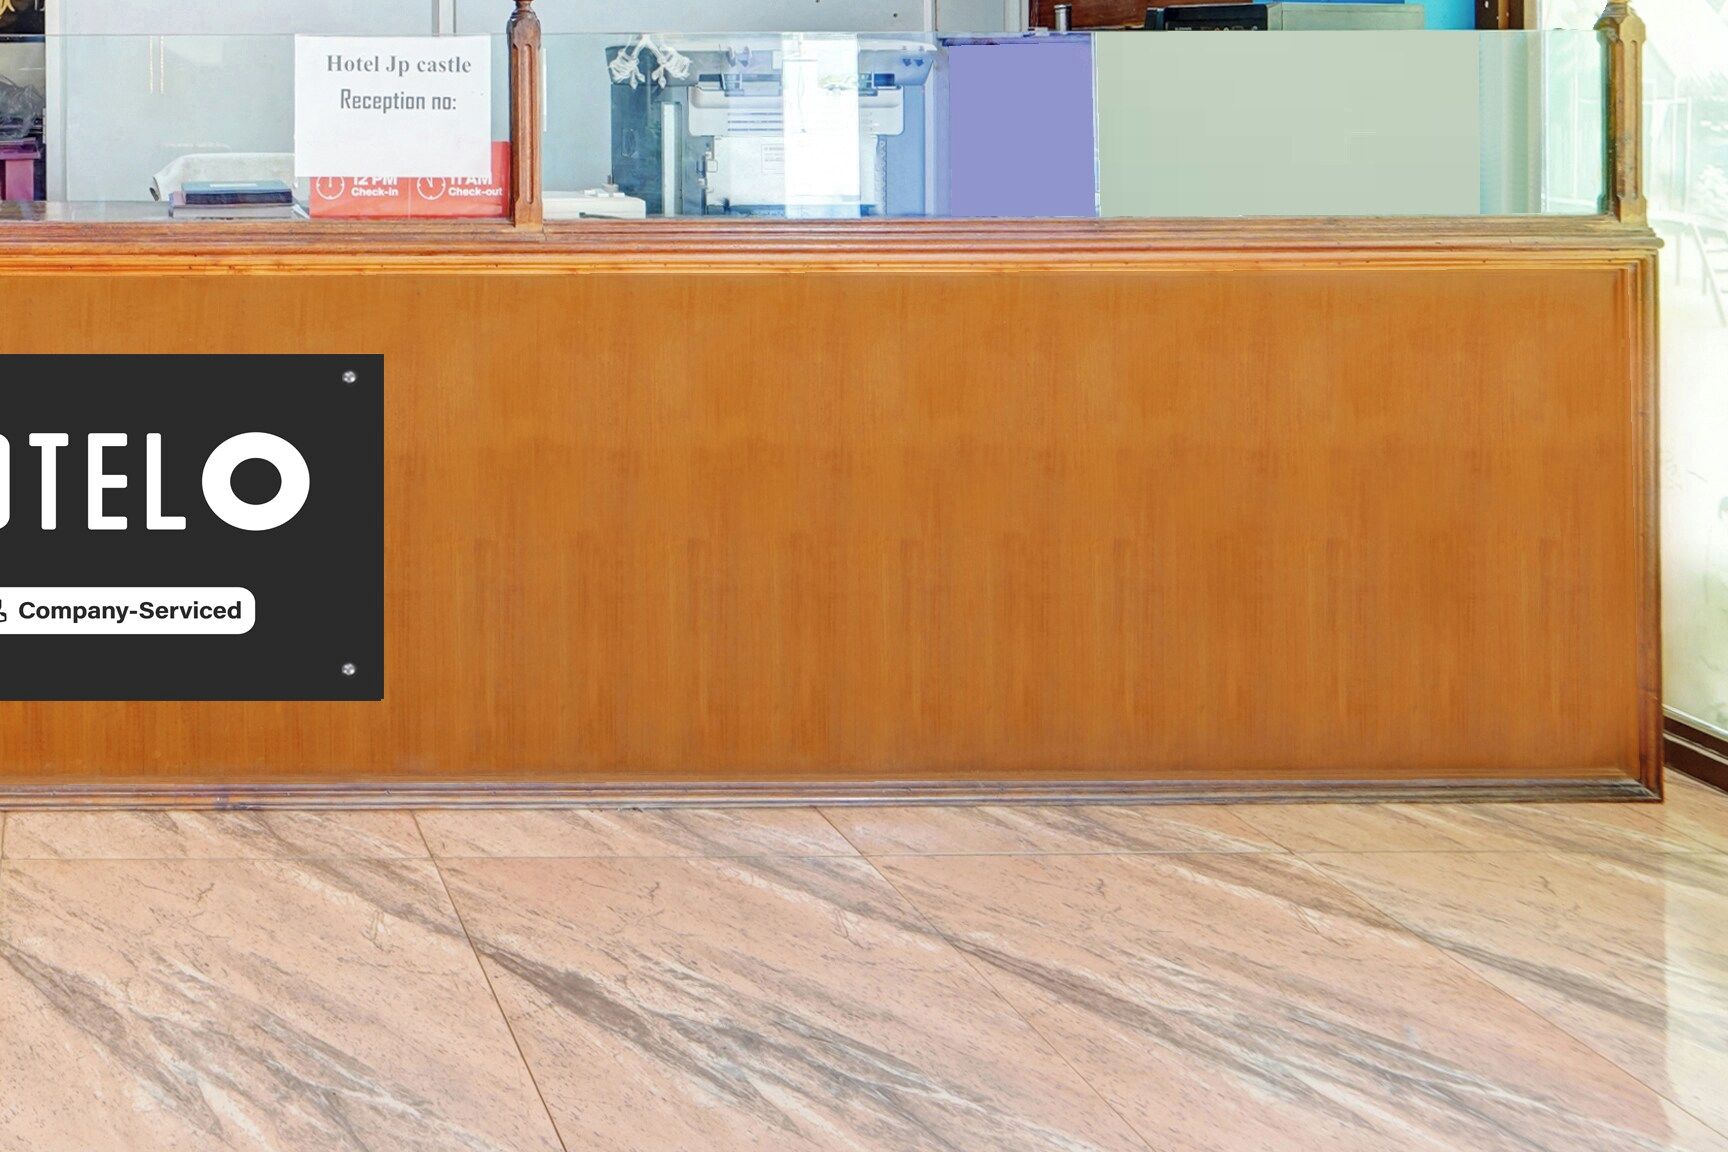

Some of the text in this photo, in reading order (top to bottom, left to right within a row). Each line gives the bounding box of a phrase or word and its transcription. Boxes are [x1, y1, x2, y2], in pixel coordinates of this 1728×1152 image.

[326, 54, 472, 78] Hotel Jp castle
[340, 88, 457, 114] Reception no:
[351, 187, 398, 196] Check-in
[448, 187, 504, 196] Check-out
[201, 431, 311, 531] O
[17, 600, 242, 624] Company-Serviced
